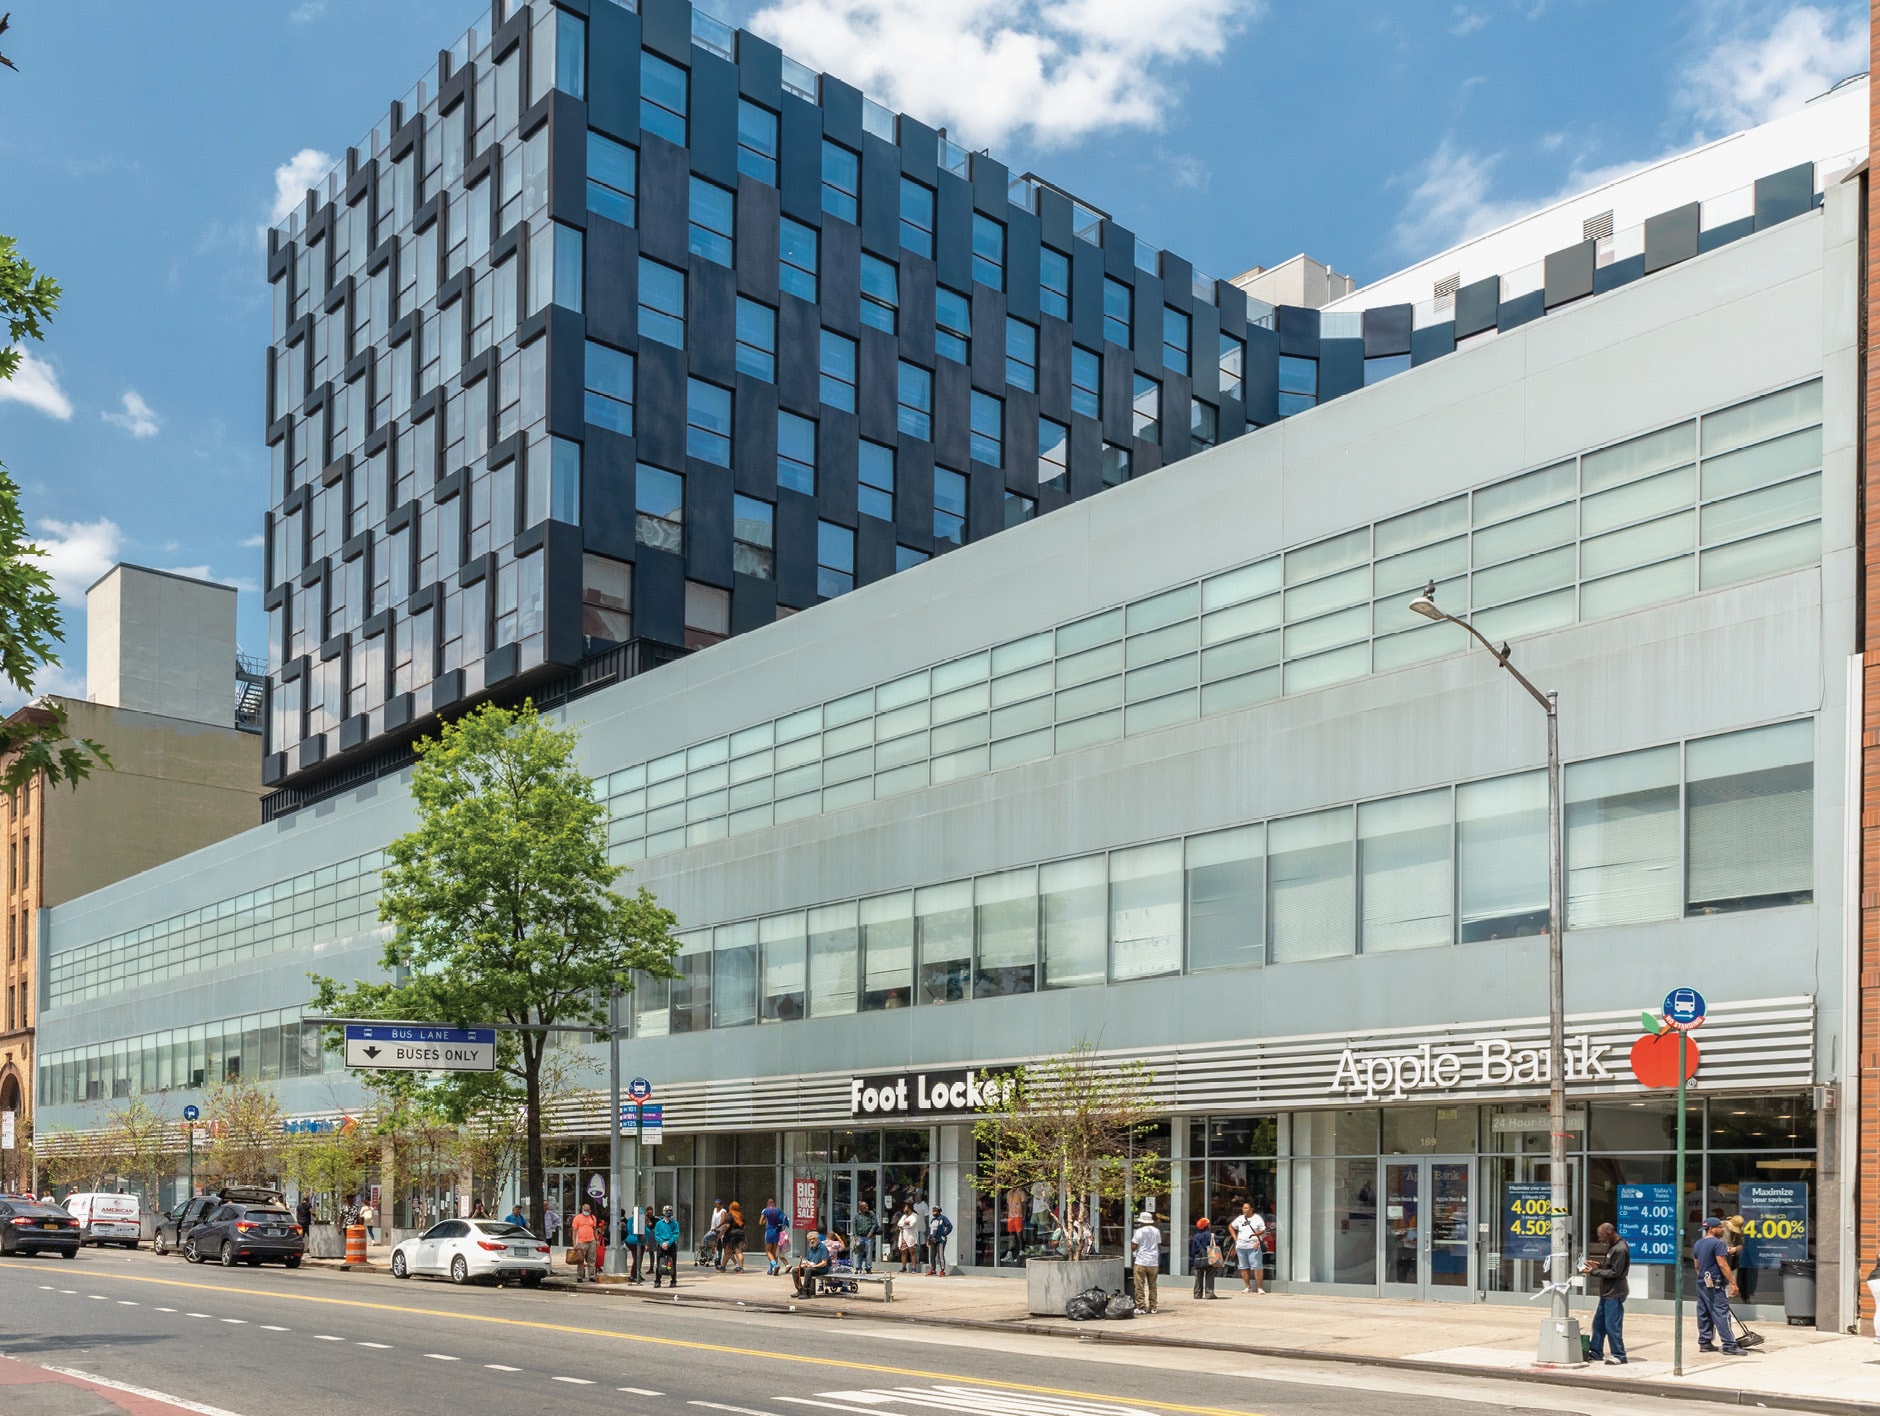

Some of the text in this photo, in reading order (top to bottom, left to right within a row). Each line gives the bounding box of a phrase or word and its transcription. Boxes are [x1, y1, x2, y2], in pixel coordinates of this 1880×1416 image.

[1674, 1018, 1703, 1029] STANDING
[392, 1029, 449, 1040] BUS LANE
[397, 1048, 479, 1061] BUSES ONLY
[1327, 1034, 1614, 1100] Apple Bank
[852, 1078, 908, 1112] Foot
[1494, 1117, 1584, 1128] 24 Hour Baing
[1434, 1171, 1460, 1180] Bank
[797, 1183, 814, 1197] BIG
[1752, 1188, 1793, 1196] Maximize
[798, 1198, 814, 1208] NIKE
[797, 1208, 814, 1218] SALE
[1743, 1220, 1805, 1239] 4.00%
